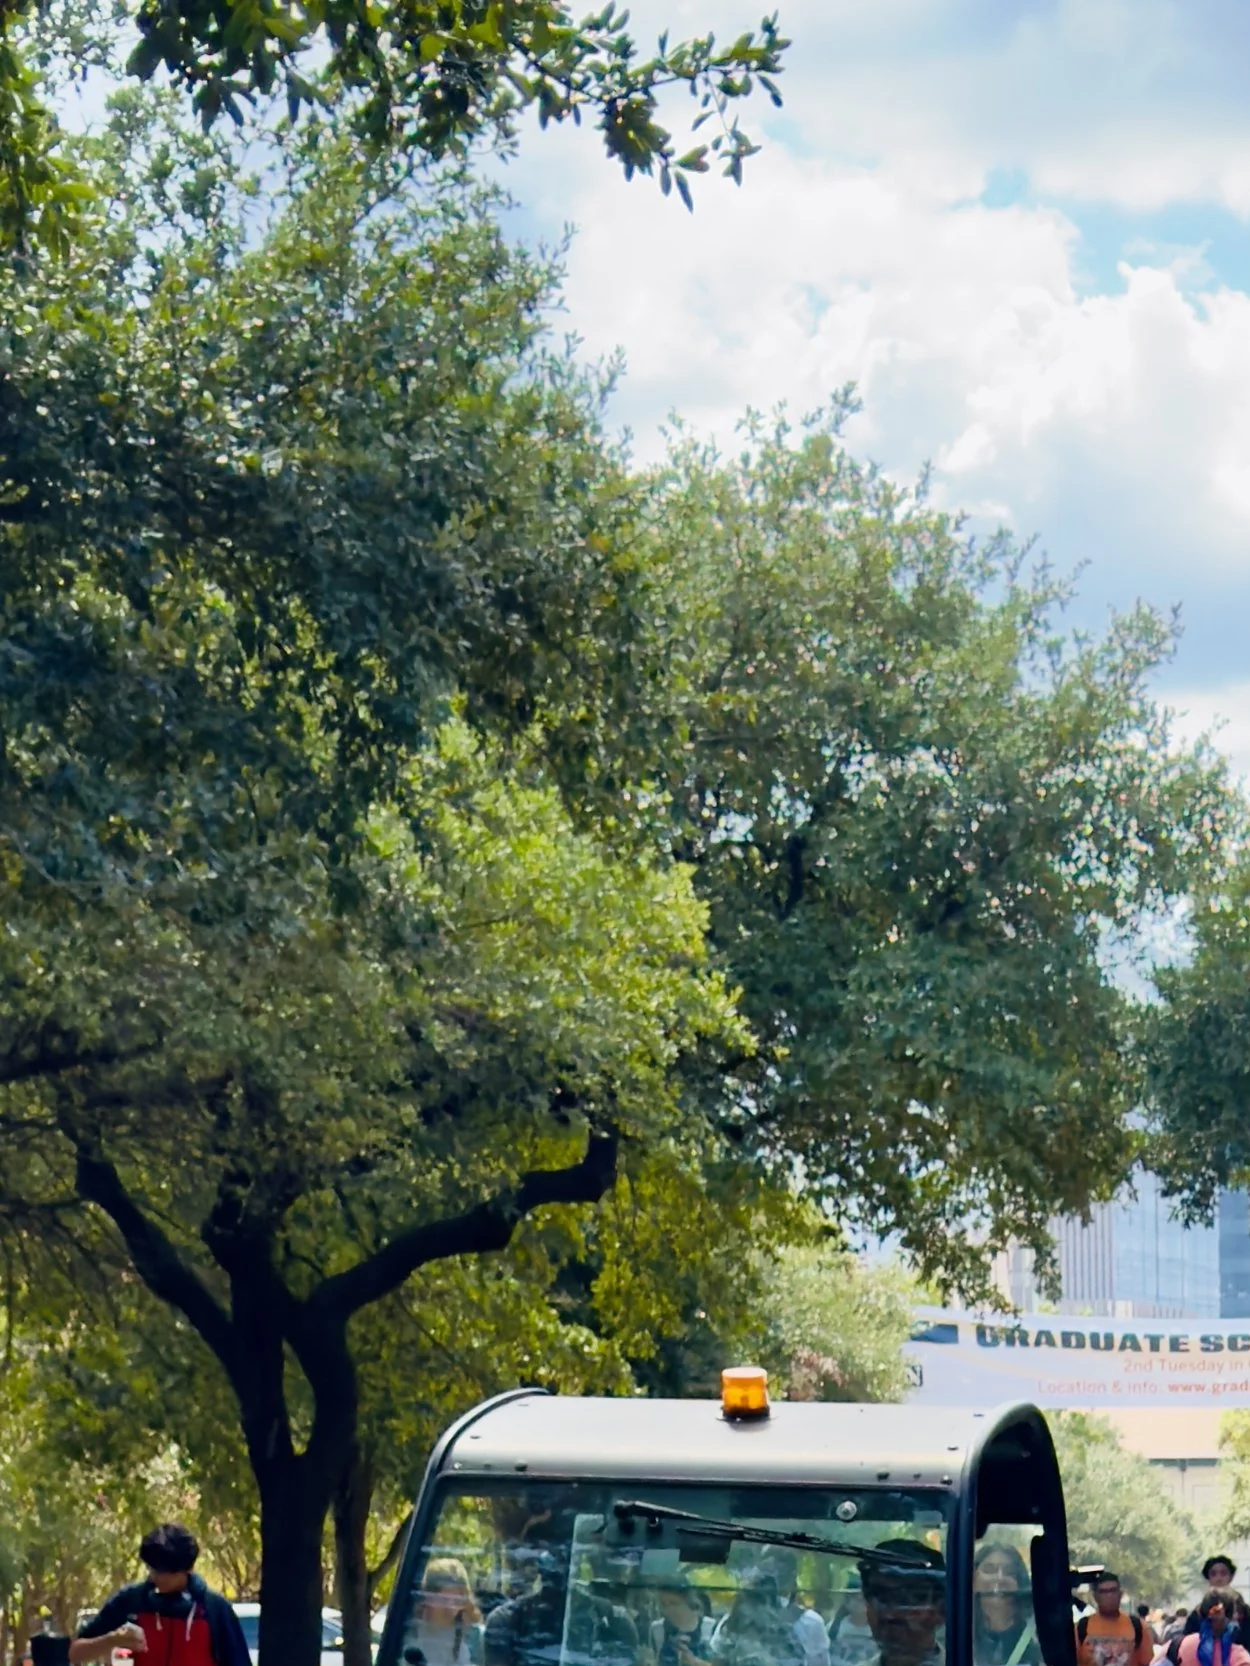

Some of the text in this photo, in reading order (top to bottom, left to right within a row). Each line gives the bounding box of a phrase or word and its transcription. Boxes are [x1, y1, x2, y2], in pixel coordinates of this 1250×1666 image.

[975, 1324, 1191, 1353] GRADUATE
[1123, 1358, 1153, 1373] 2nd
[1159, 1358, 1225, 1375] Tuesday
[1230, 1359, 1244, 1372] in
[1038, 1379, 1106, 1395] Location
[1111, 1380, 1123, 1394] &
